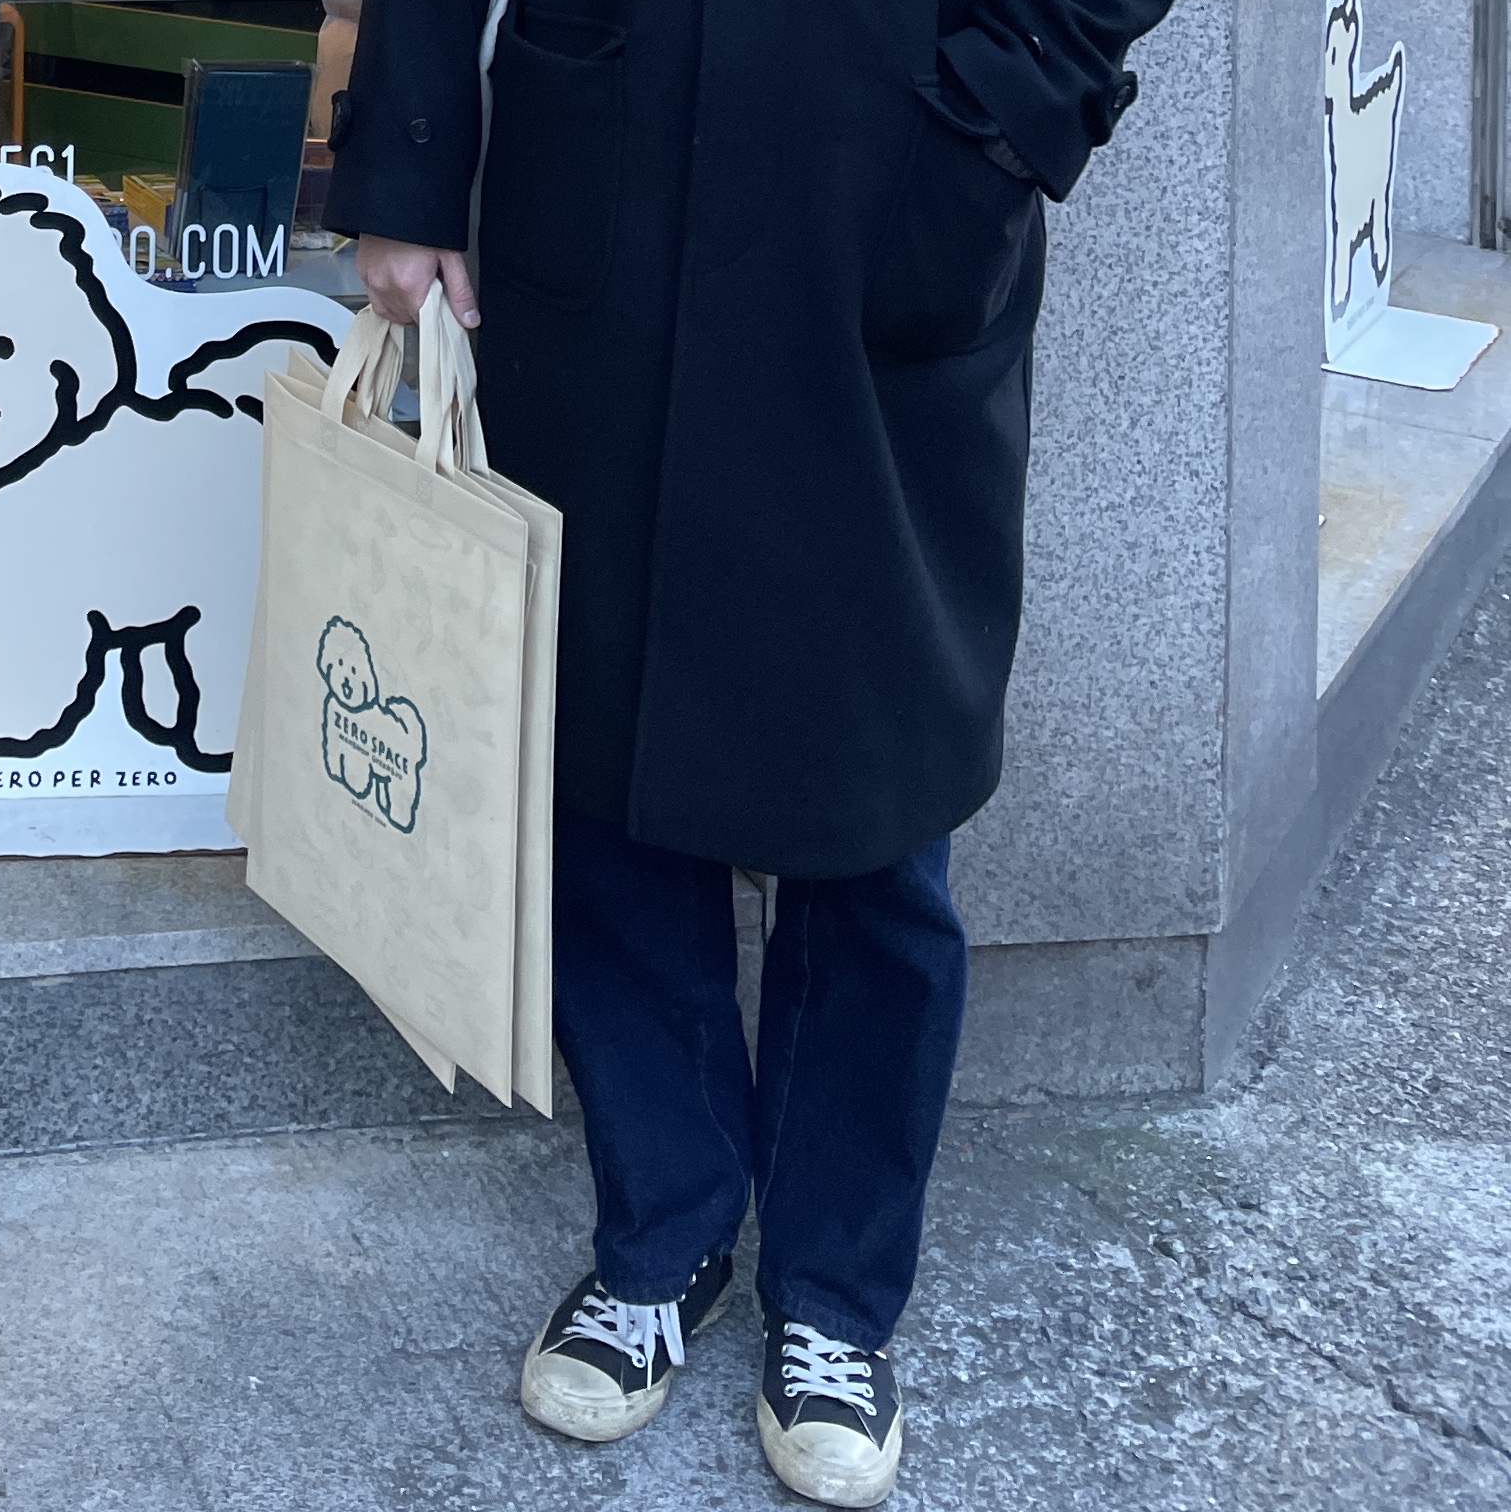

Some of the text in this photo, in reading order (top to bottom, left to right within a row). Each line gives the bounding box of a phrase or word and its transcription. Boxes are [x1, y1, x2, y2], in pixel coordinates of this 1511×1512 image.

[334, 710, 368, 745] ZERO
[371, 736, 409, 775] SPACE
[53, 769, 102, 788] PER
[115, 770, 177, 787] ZERO
